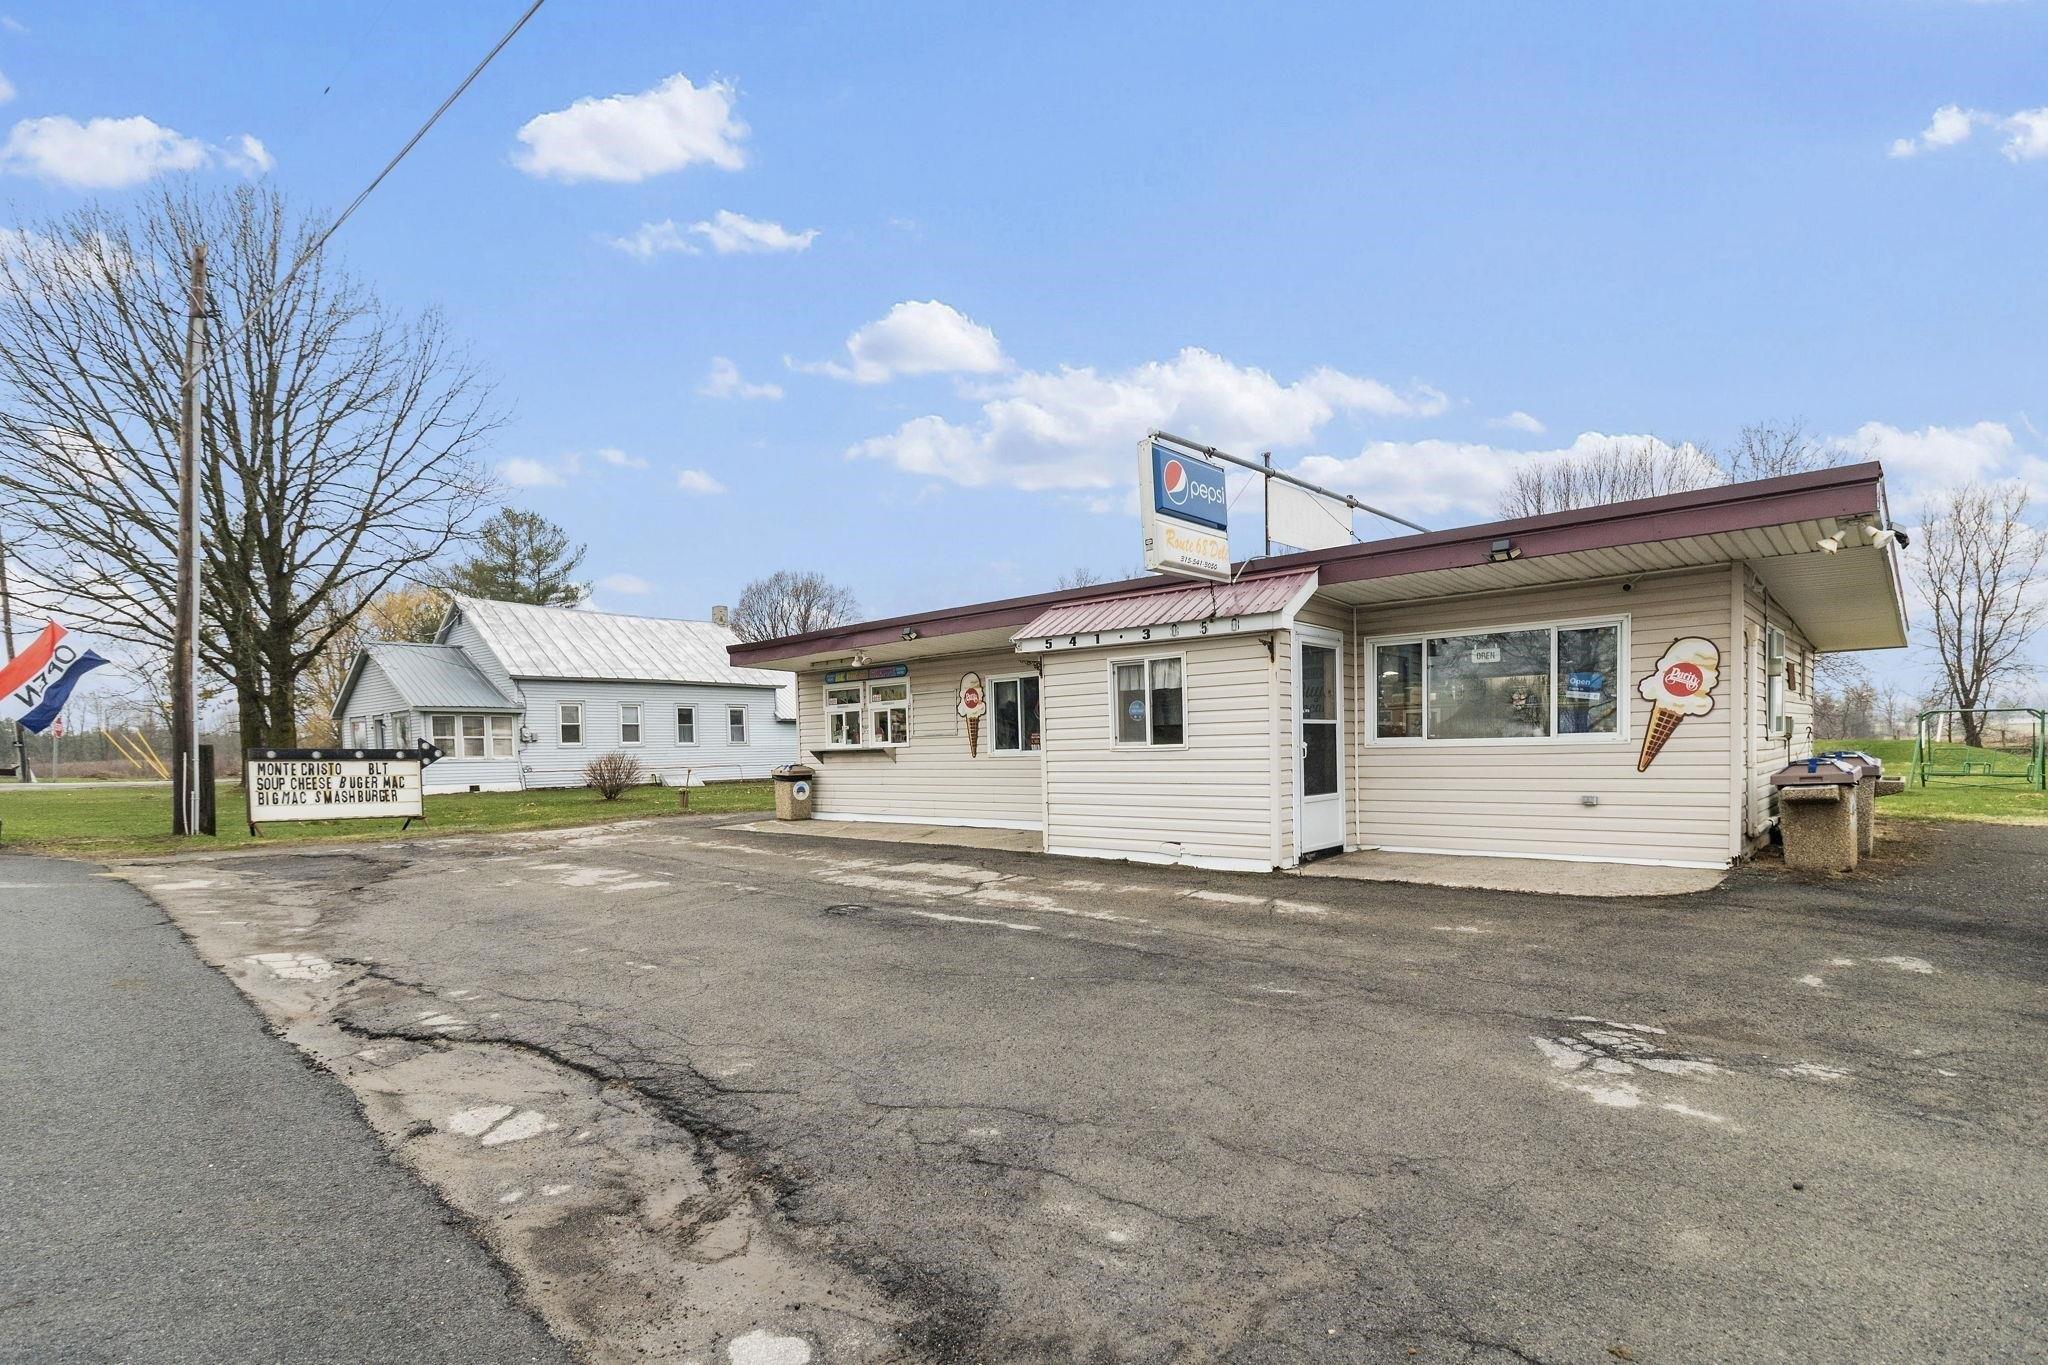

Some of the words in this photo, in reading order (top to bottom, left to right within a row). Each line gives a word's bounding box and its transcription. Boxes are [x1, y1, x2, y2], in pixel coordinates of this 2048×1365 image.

[1190, 480, 1225, 505] pepsi
[1476, 651, 1495, 660] OPEN
[1569, 677, 1591, 686] Open
[1664, 667, 1700, 691] Purity
[257, 762, 297, 776] MONTE
[301, 762, 342, 775] CRISTO
[368, 762, 388, 775] BLT
[256, 777, 286, 791] SOUP
[290, 776, 332, 790] CHEESE
[383, 775, 405, 789] MAC
